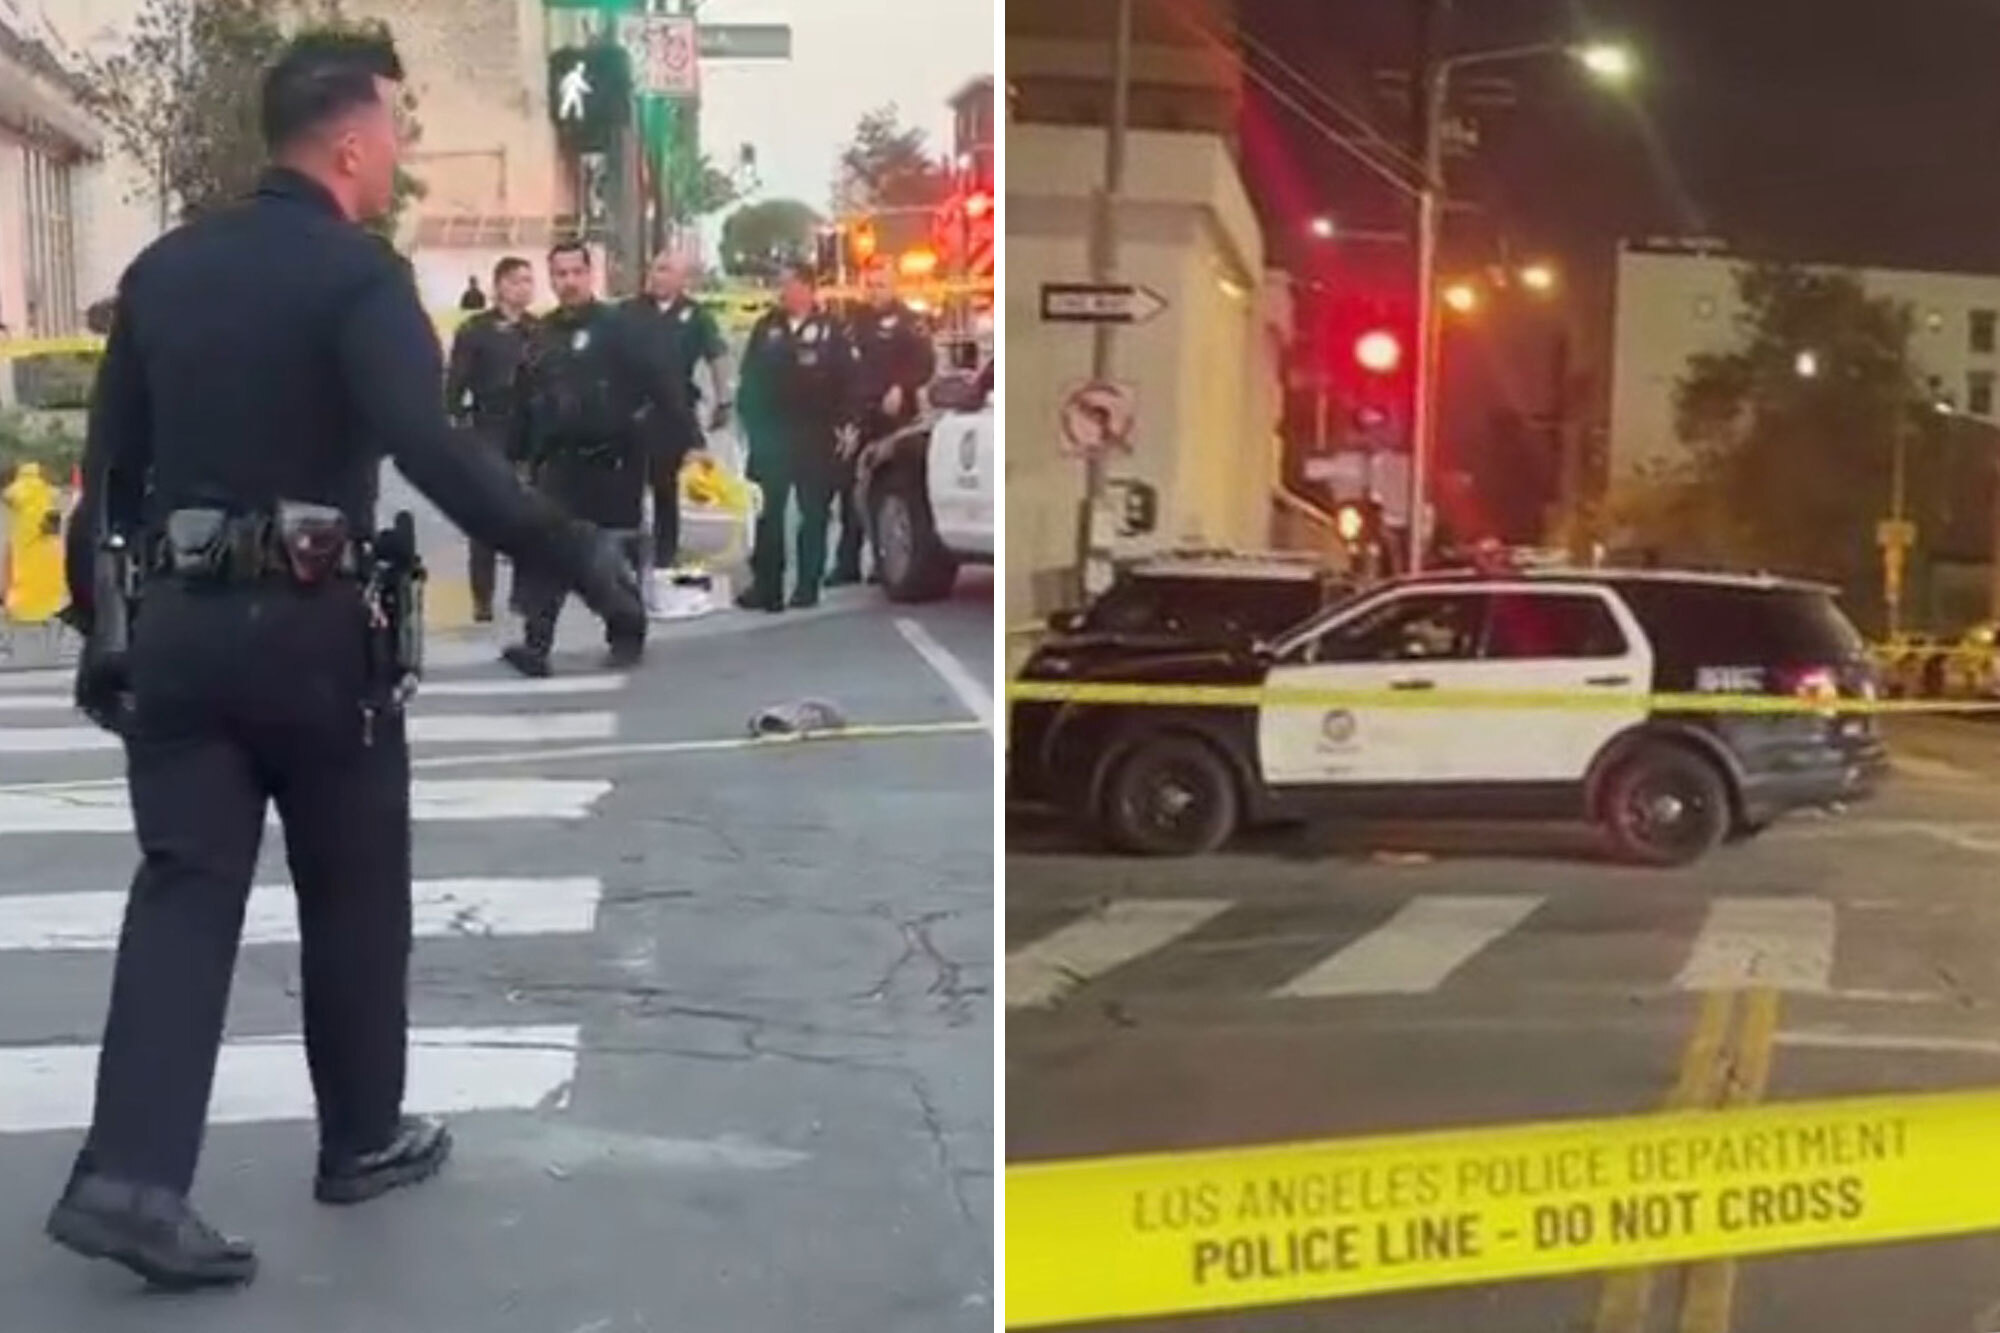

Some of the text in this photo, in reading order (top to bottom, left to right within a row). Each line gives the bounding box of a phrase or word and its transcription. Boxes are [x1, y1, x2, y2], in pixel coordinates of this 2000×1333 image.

[1132, 1118, 1907, 1232] LOS ANGELES POLICE DEPARTMENT
[1193, 1225, 1361, 1286] POLICE
[1376, 1213, 1482, 1266] LINE
[1534, 1203, 1594, 1249] DO
[1609, 1191, 1701, 1244] NOT
[1717, 1176, 1864, 1231] CROSS
